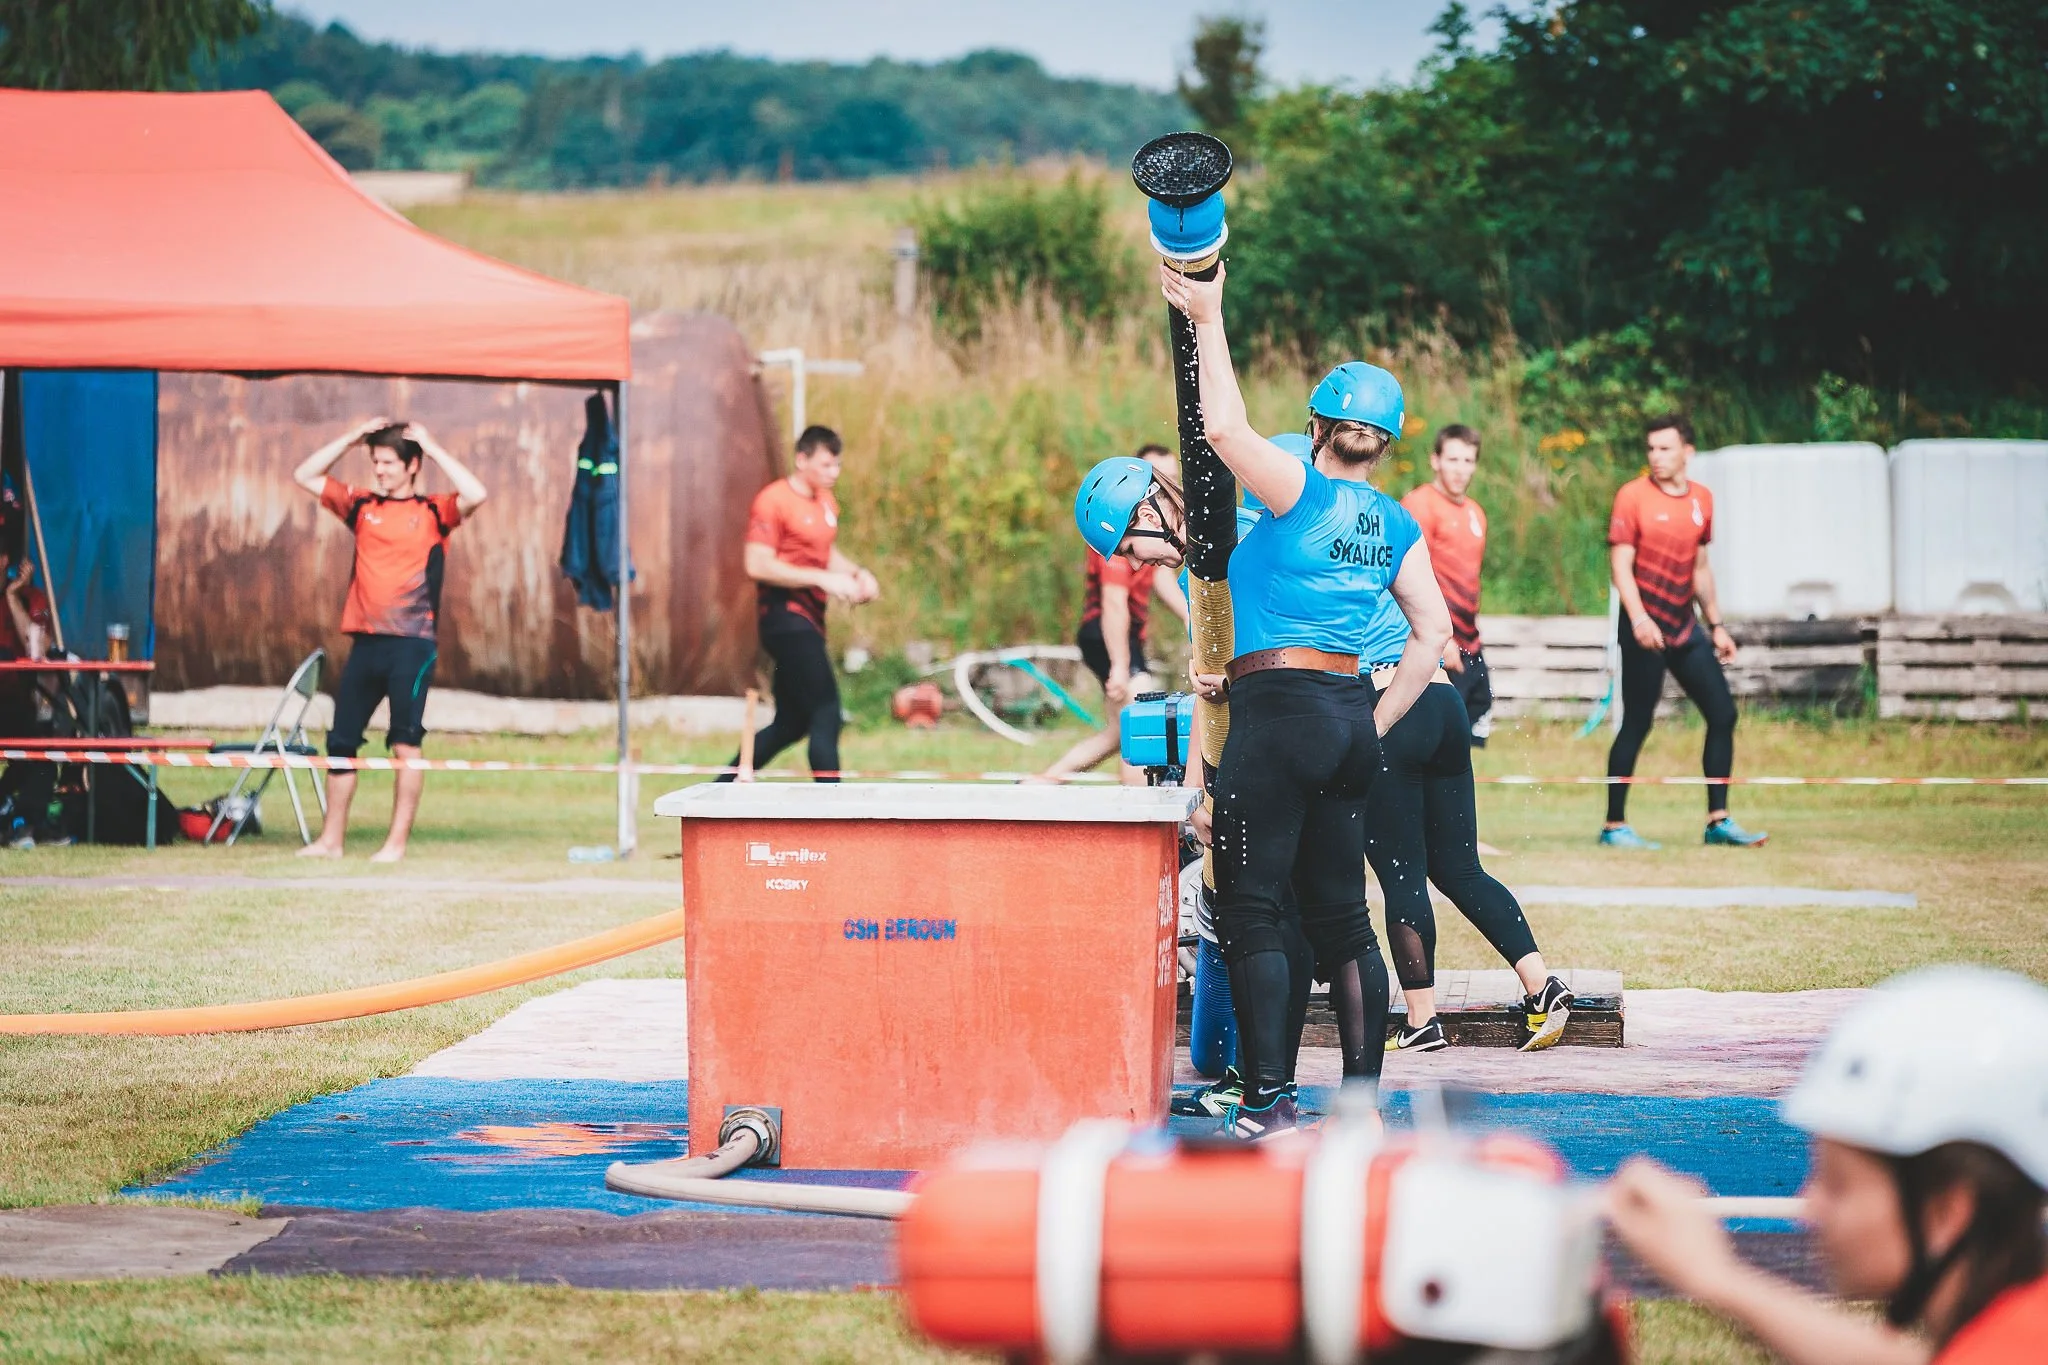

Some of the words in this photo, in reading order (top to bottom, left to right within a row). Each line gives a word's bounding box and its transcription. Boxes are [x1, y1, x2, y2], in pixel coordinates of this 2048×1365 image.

[1356, 513, 1380, 536] SDH
[1329, 538, 1393, 567] SKALICE
[844, 918, 879, 940] OSH
[885, 918, 957, 940] BEROUN
